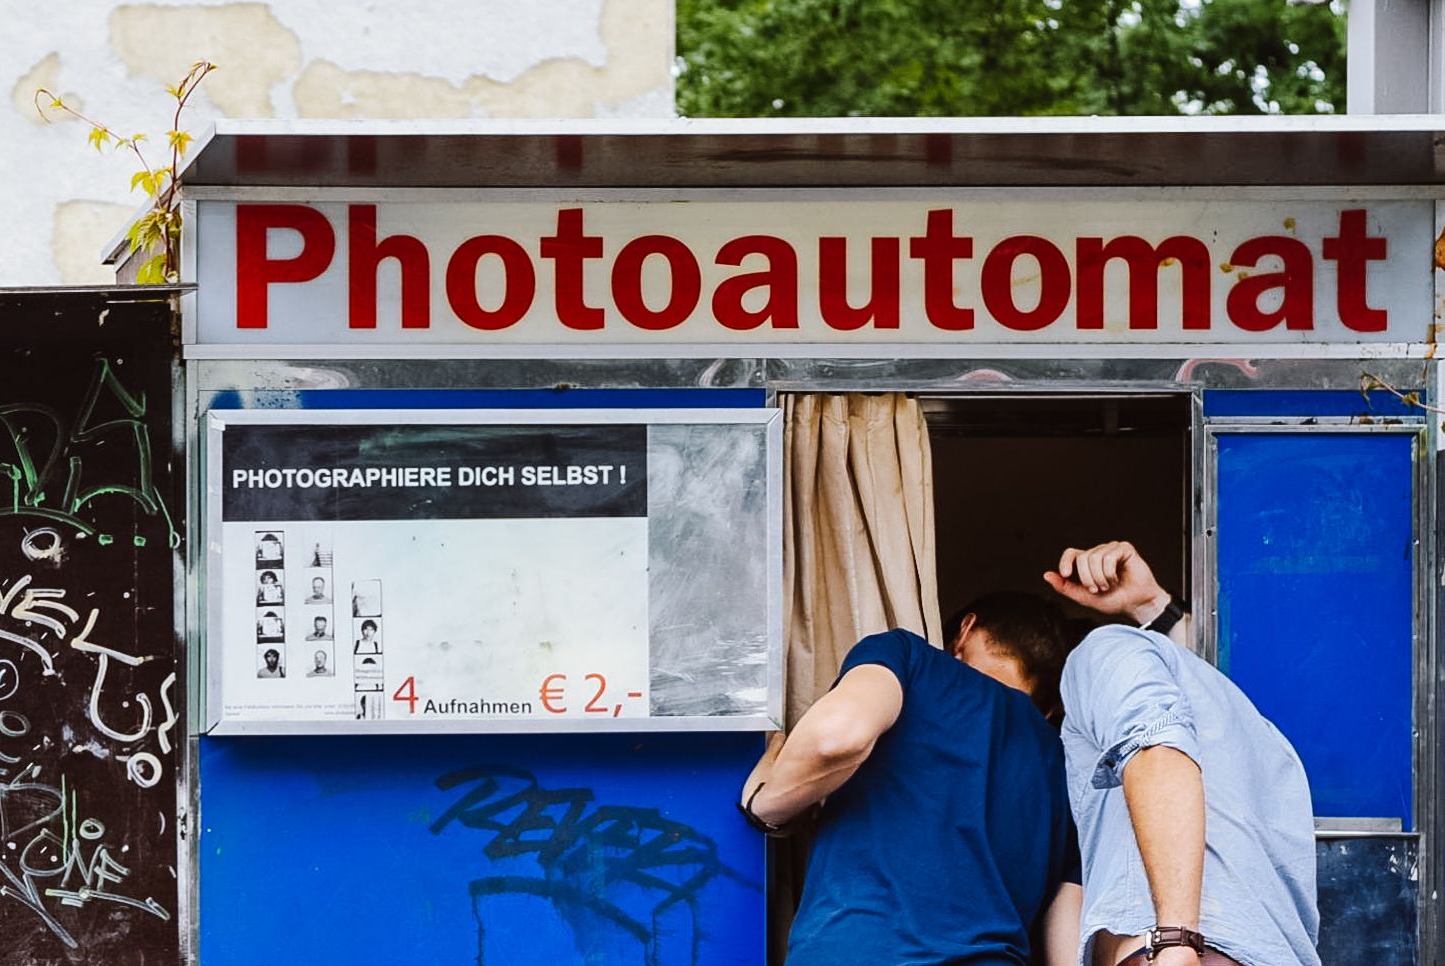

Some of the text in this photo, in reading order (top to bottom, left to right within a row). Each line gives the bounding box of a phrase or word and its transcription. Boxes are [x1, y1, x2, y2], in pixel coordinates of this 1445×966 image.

[235, 203, 1389, 333] Photoautomat
[232, 466, 452, 490] PHOTOGRAPHIERE
[457, 466, 514, 487] DICH
[520, 465, 614, 487] SELBST
[392, 676, 419, 714] 4
[423, 698, 533, 714] Aufnahmen
[539, 673, 567, 714] €
